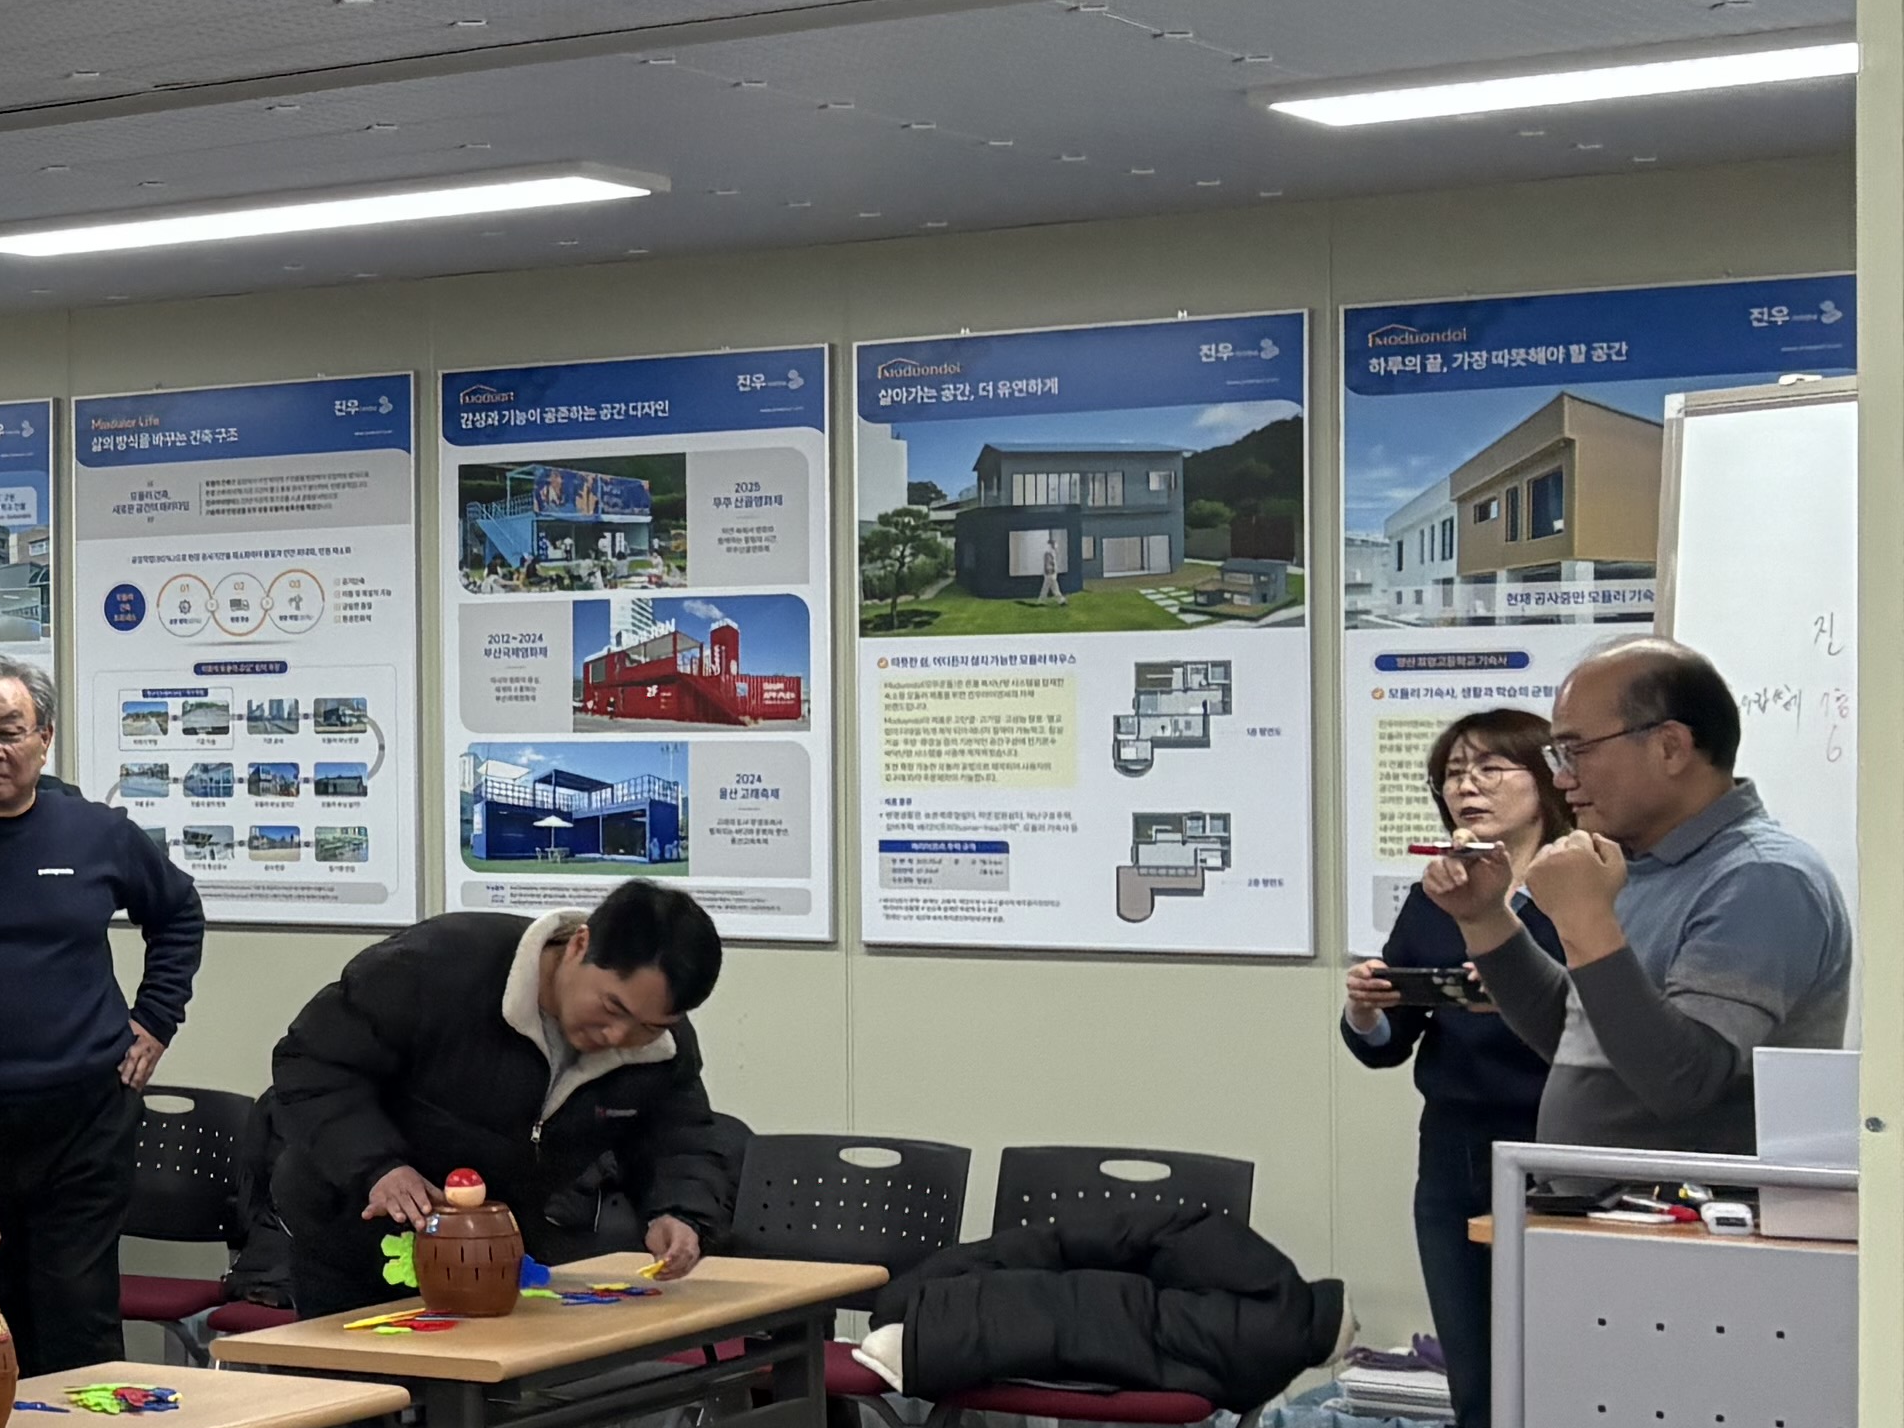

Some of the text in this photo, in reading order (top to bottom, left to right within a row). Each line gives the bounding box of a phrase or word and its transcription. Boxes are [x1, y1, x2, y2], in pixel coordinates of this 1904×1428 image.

[1749, 306, 1789, 327] 진우
[1199, 343, 1234, 362] 진우
[1369, 342, 1628, 376] 하루의 끝, 가장 따뜻해야 할 공간
[737, 373, 767, 391] 진우
[879, 377, 1059, 406] 살아가는 공간, 더 유연하게
[334, 399, 359, 416] 진우
[461, 400, 669, 429] 감성과 기능이 공존하는 공간 디자인
[91, 428, 239, 452] 삶의 방식을 바꾸는 건축 구조
[1588, 589, 1625, 604] 모듈러
[1629, 588, 1655, 603] 기숙
